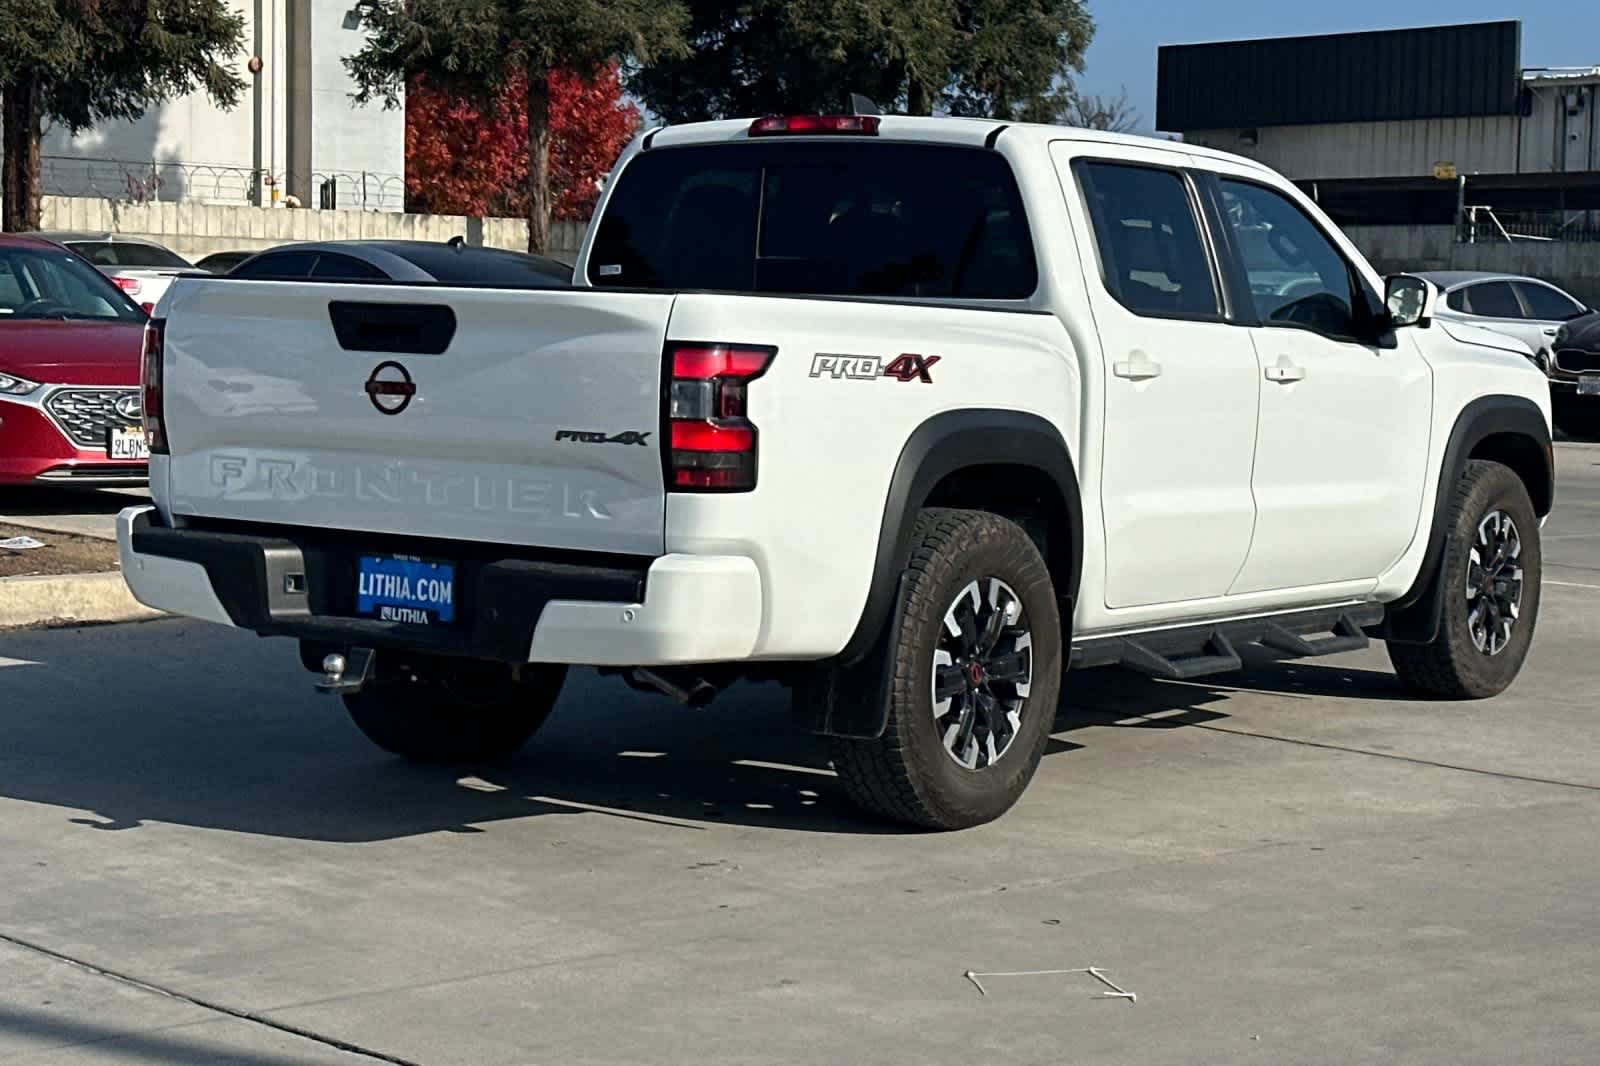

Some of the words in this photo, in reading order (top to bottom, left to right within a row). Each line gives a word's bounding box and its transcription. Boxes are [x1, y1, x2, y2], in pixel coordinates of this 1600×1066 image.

[808, 353, 941, 384] PRO-4X
[210, 454, 613, 520] FRONTIER
[359, 571, 452, 604] LITHIA.COM
[391, 607, 428, 624] LITHIA
